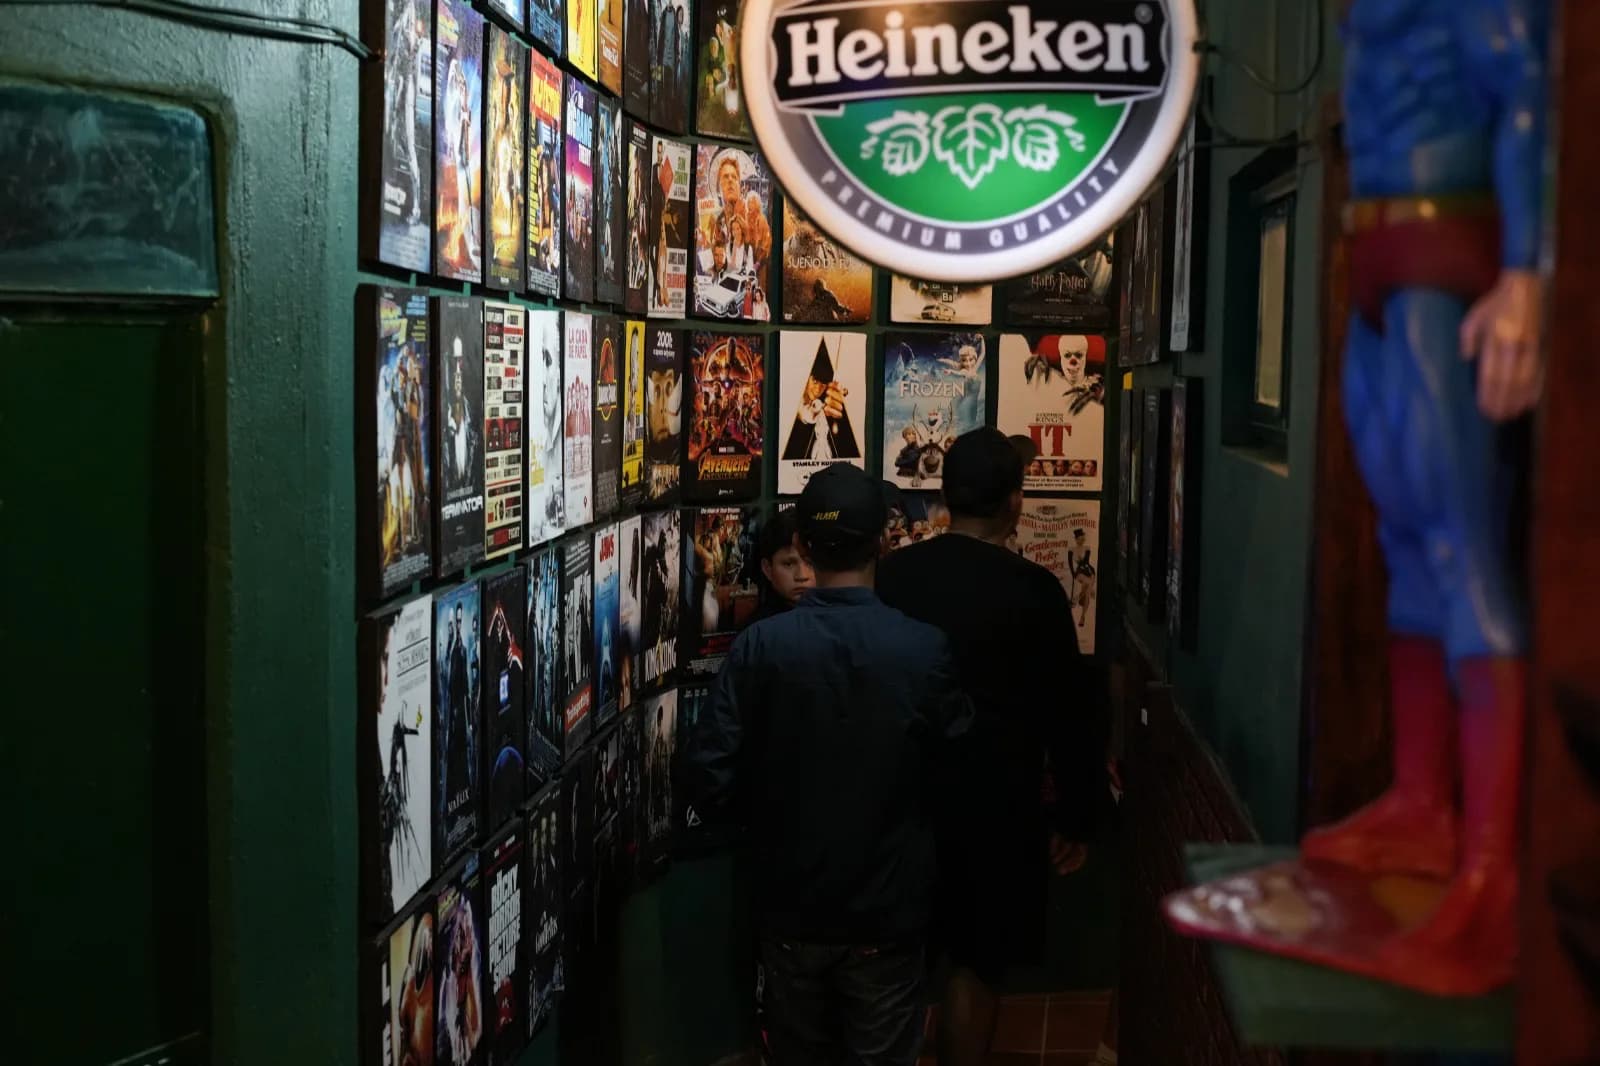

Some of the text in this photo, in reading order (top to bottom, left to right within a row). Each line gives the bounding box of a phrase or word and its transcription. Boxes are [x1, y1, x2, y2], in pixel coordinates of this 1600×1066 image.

[786, 5, 1151, 87] Heineken
[820, 157, 1122, 250] PREMIUM QUALITY
[788, 255, 821, 269] SUEÑO
[1059, 271, 1088, 294] Potter
[900, 381, 965, 398] FROZEN
[1028, 425, 1072, 456] IT
[698, 449, 752, 477] AVENGERS
